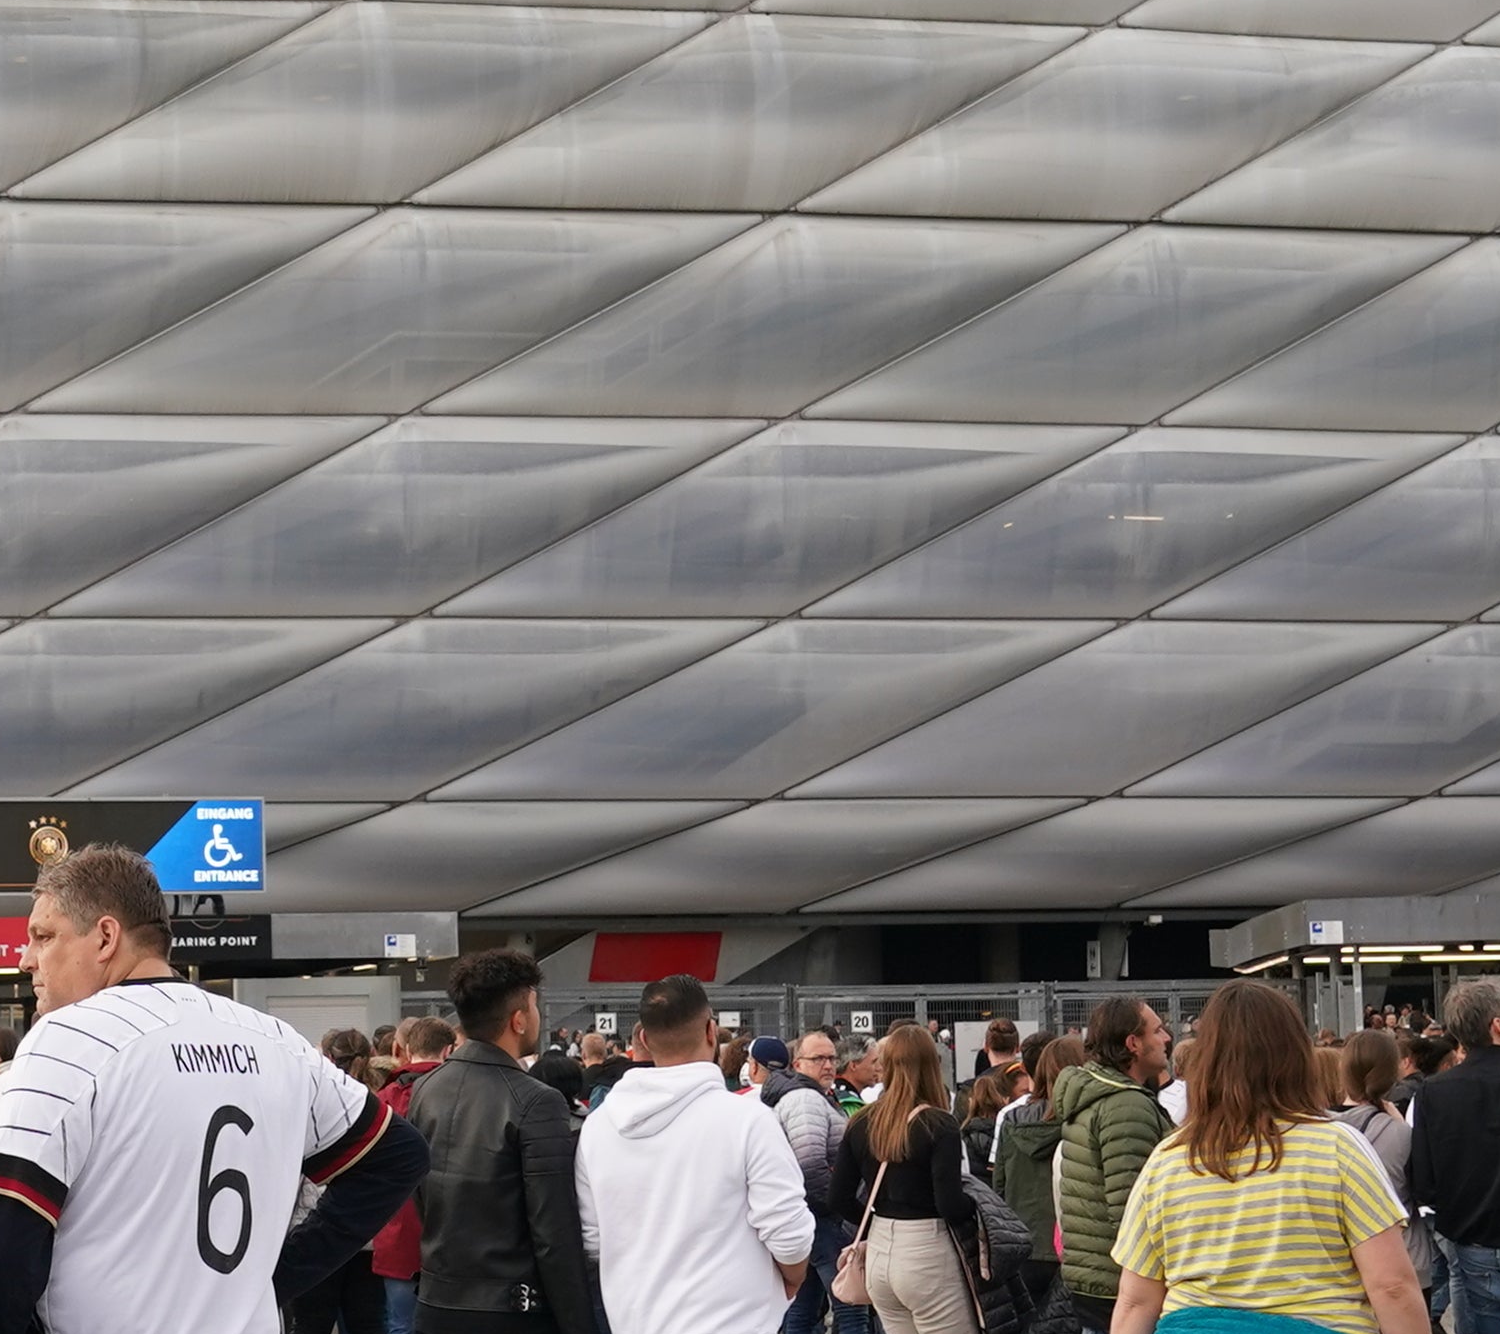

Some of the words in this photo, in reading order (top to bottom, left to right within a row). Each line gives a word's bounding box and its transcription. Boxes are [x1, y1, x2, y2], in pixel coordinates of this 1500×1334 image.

[196, 808, 254, 820] EINGANG
[193, 869, 259, 882] ENTRANCE
[220, 936, 258, 947] POINT
[599, 1017, 613, 1030] 21
[854, 1015, 869, 1028] 20
[170, 1043, 260, 1075] KIMMICH
[196, 1104, 255, 1275] 6
